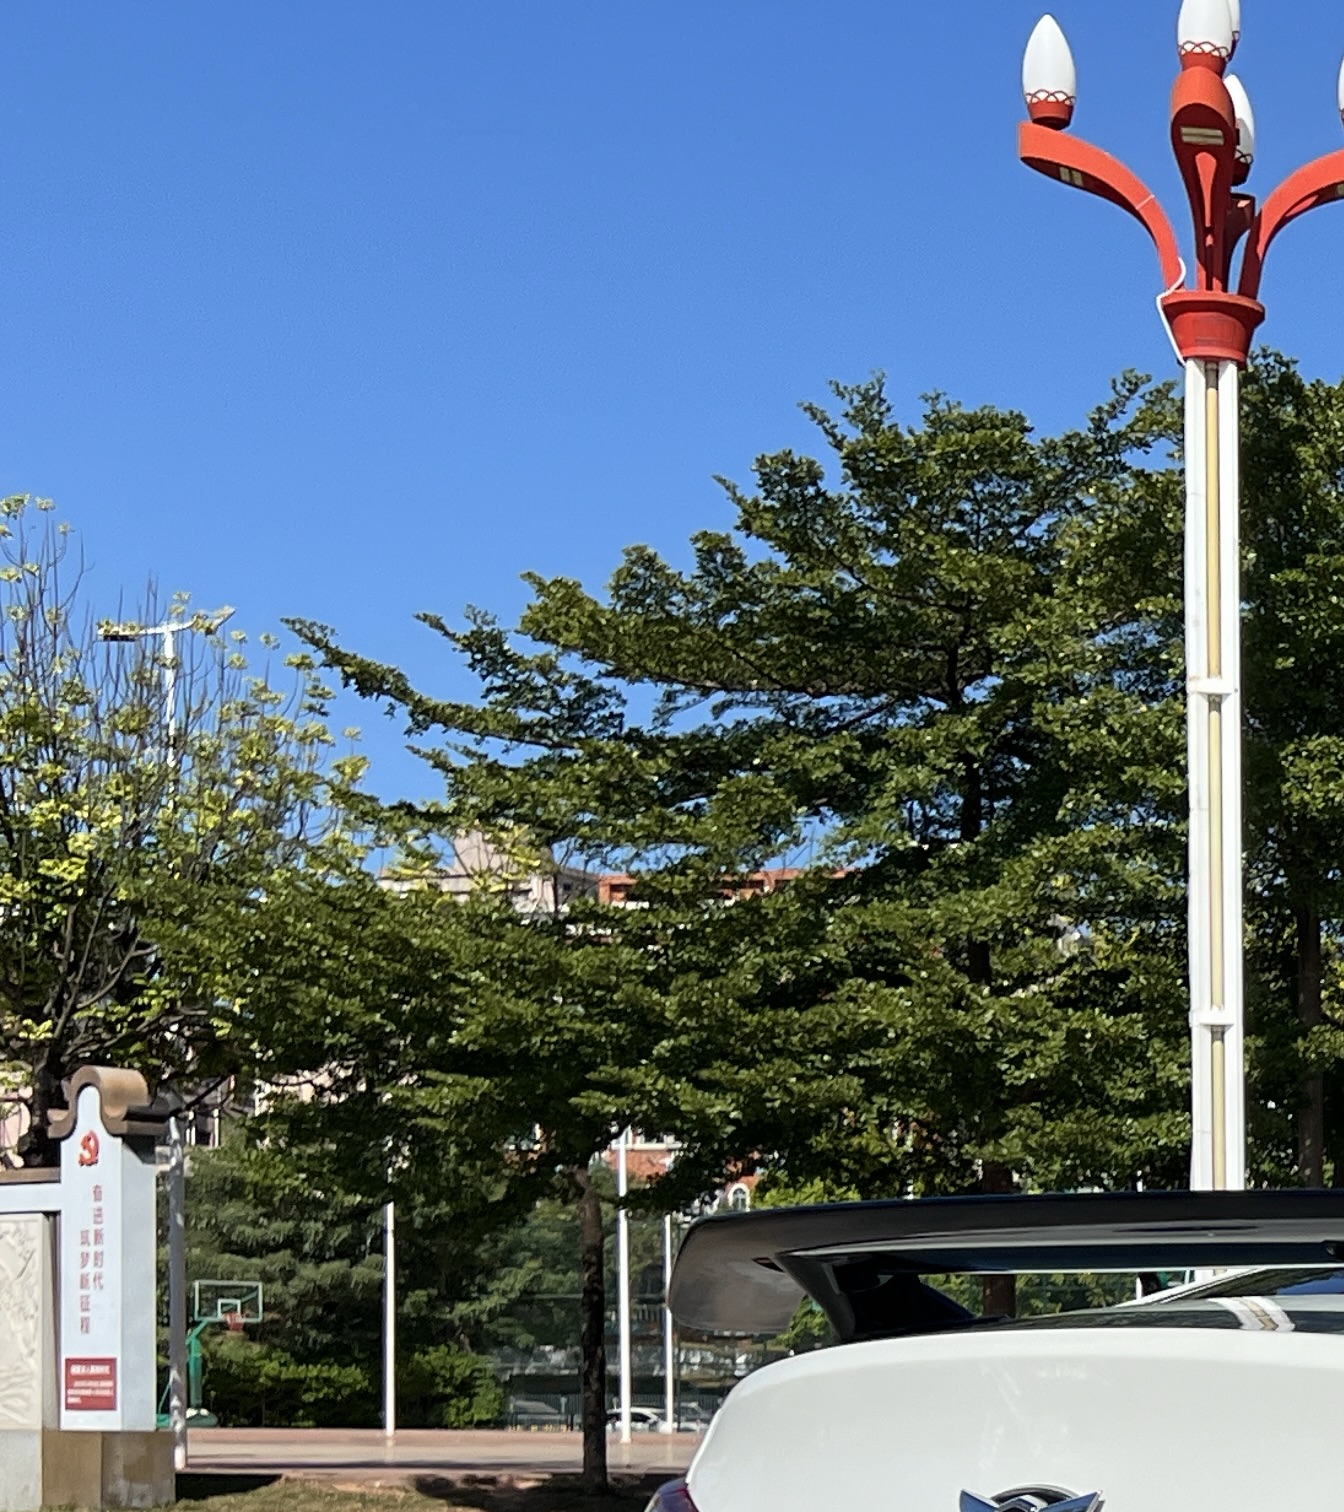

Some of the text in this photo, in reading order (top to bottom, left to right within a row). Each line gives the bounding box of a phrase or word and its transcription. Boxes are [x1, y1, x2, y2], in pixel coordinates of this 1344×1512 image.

[94, 1185, 103, 1290] 奋进新时代
